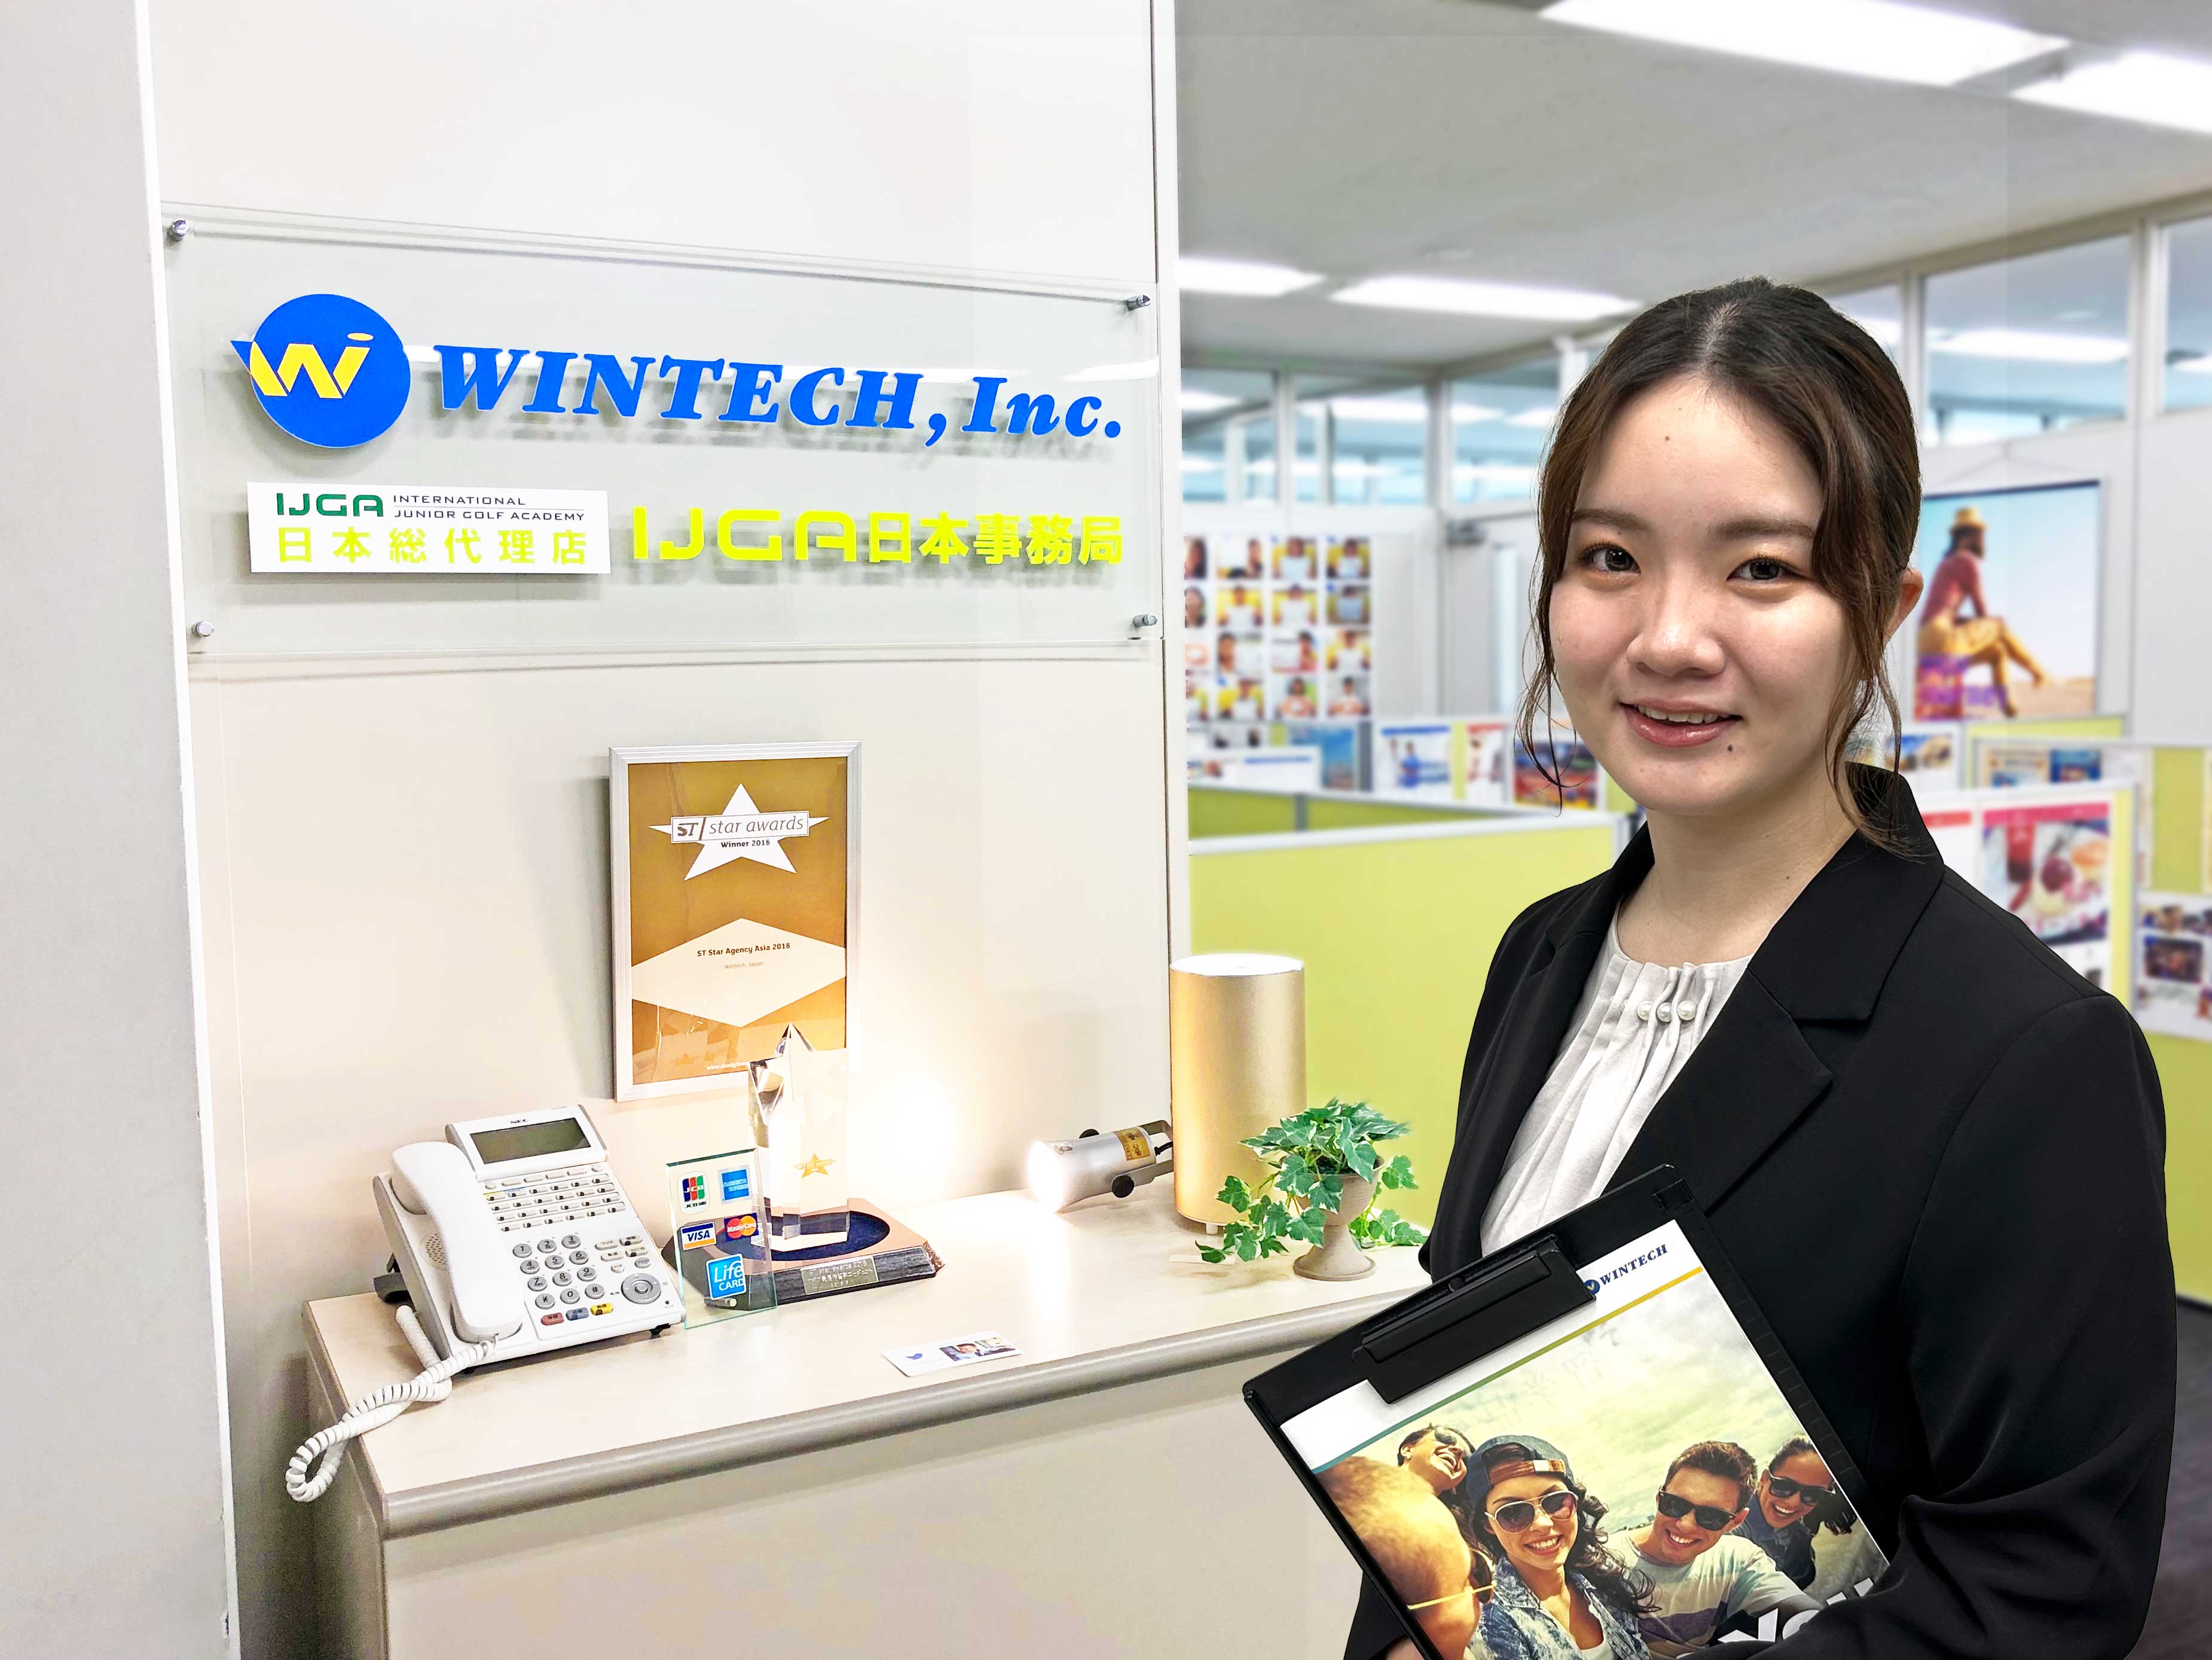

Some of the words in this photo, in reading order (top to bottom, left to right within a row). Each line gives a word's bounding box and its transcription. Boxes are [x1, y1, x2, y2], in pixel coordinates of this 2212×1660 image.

[276, 493, 384, 517] IJGA
[393, 495, 525, 506] INTERNATIONAL
[394, 509, 456, 519] JUNIOR
[463, 511, 505, 520] GOLF
[511, 512, 585, 521] ACADEMY
[279, 526, 586, 564] 日本総代理店
[709, 820, 741, 834] star
[746, 816, 804, 832] awards
[726, 947, 753, 956] Agency
[683, 1185, 704, 1193] JCB
[727, 1223, 756, 1232] MasterCard
[688, 1230, 710, 1241] VISA
[1599, 1243, 1668, 1286] WINTECH
[714, 1260, 743, 1283] Life
[719, 1278, 744, 1291] CARD
